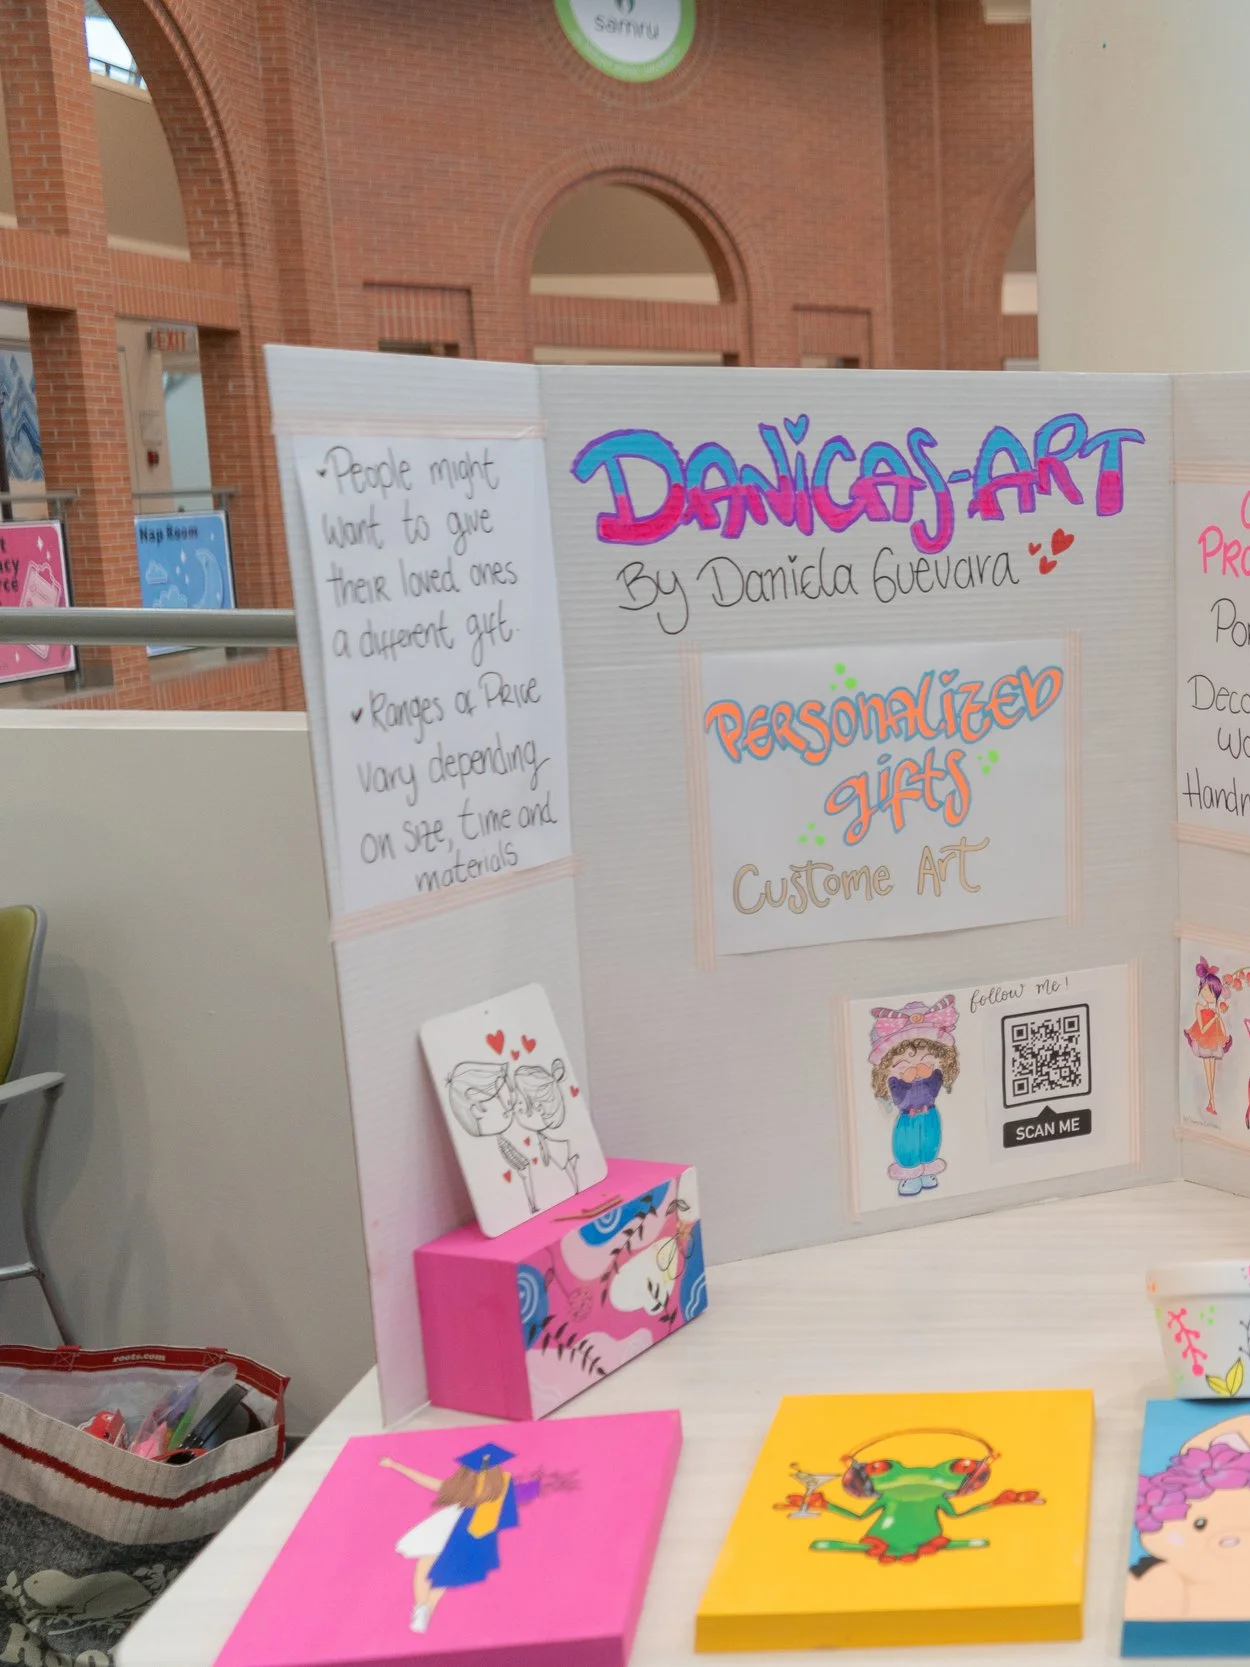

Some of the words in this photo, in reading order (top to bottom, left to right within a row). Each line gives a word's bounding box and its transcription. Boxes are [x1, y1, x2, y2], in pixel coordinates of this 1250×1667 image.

[156, 328, 185, 351] EXIT
[324, 445, 411, 500] People
[430, 448, 500, 500] might
[139, 525, 164, 547] Nap
[402, 506, 430, 545] to
[447, 506, 494, 556] give
[399, 558, 460, 599] loved
[470, 558, 519, 588] ones
[616, 559, 690, 635] By
[696, 546, 858, 608] Daniela
[872, 546, 1020, 604] Guevara
[333, 627, 351, 659] a
[360, 610, 454, 659] different
[369, 688, 445, 744] Ranges
[454, 689, 476, 718] of
[429, 739, 552, 791] depending
[824, 746, 972, 847] gifts
[361, 831, 396, 864] on
[458, 798, 512, 843] time
[518, 791, 558, 831] and
[415, 841, 519, 893] materials
[732, 860, 894, 915] Custome
[917, 836, 991, 897] Art
[970, 983, 1025, 1013] follow
[1016, 1121, 1055, 1141] SCAN
[1059, 1117, 1080, 1132] ME
